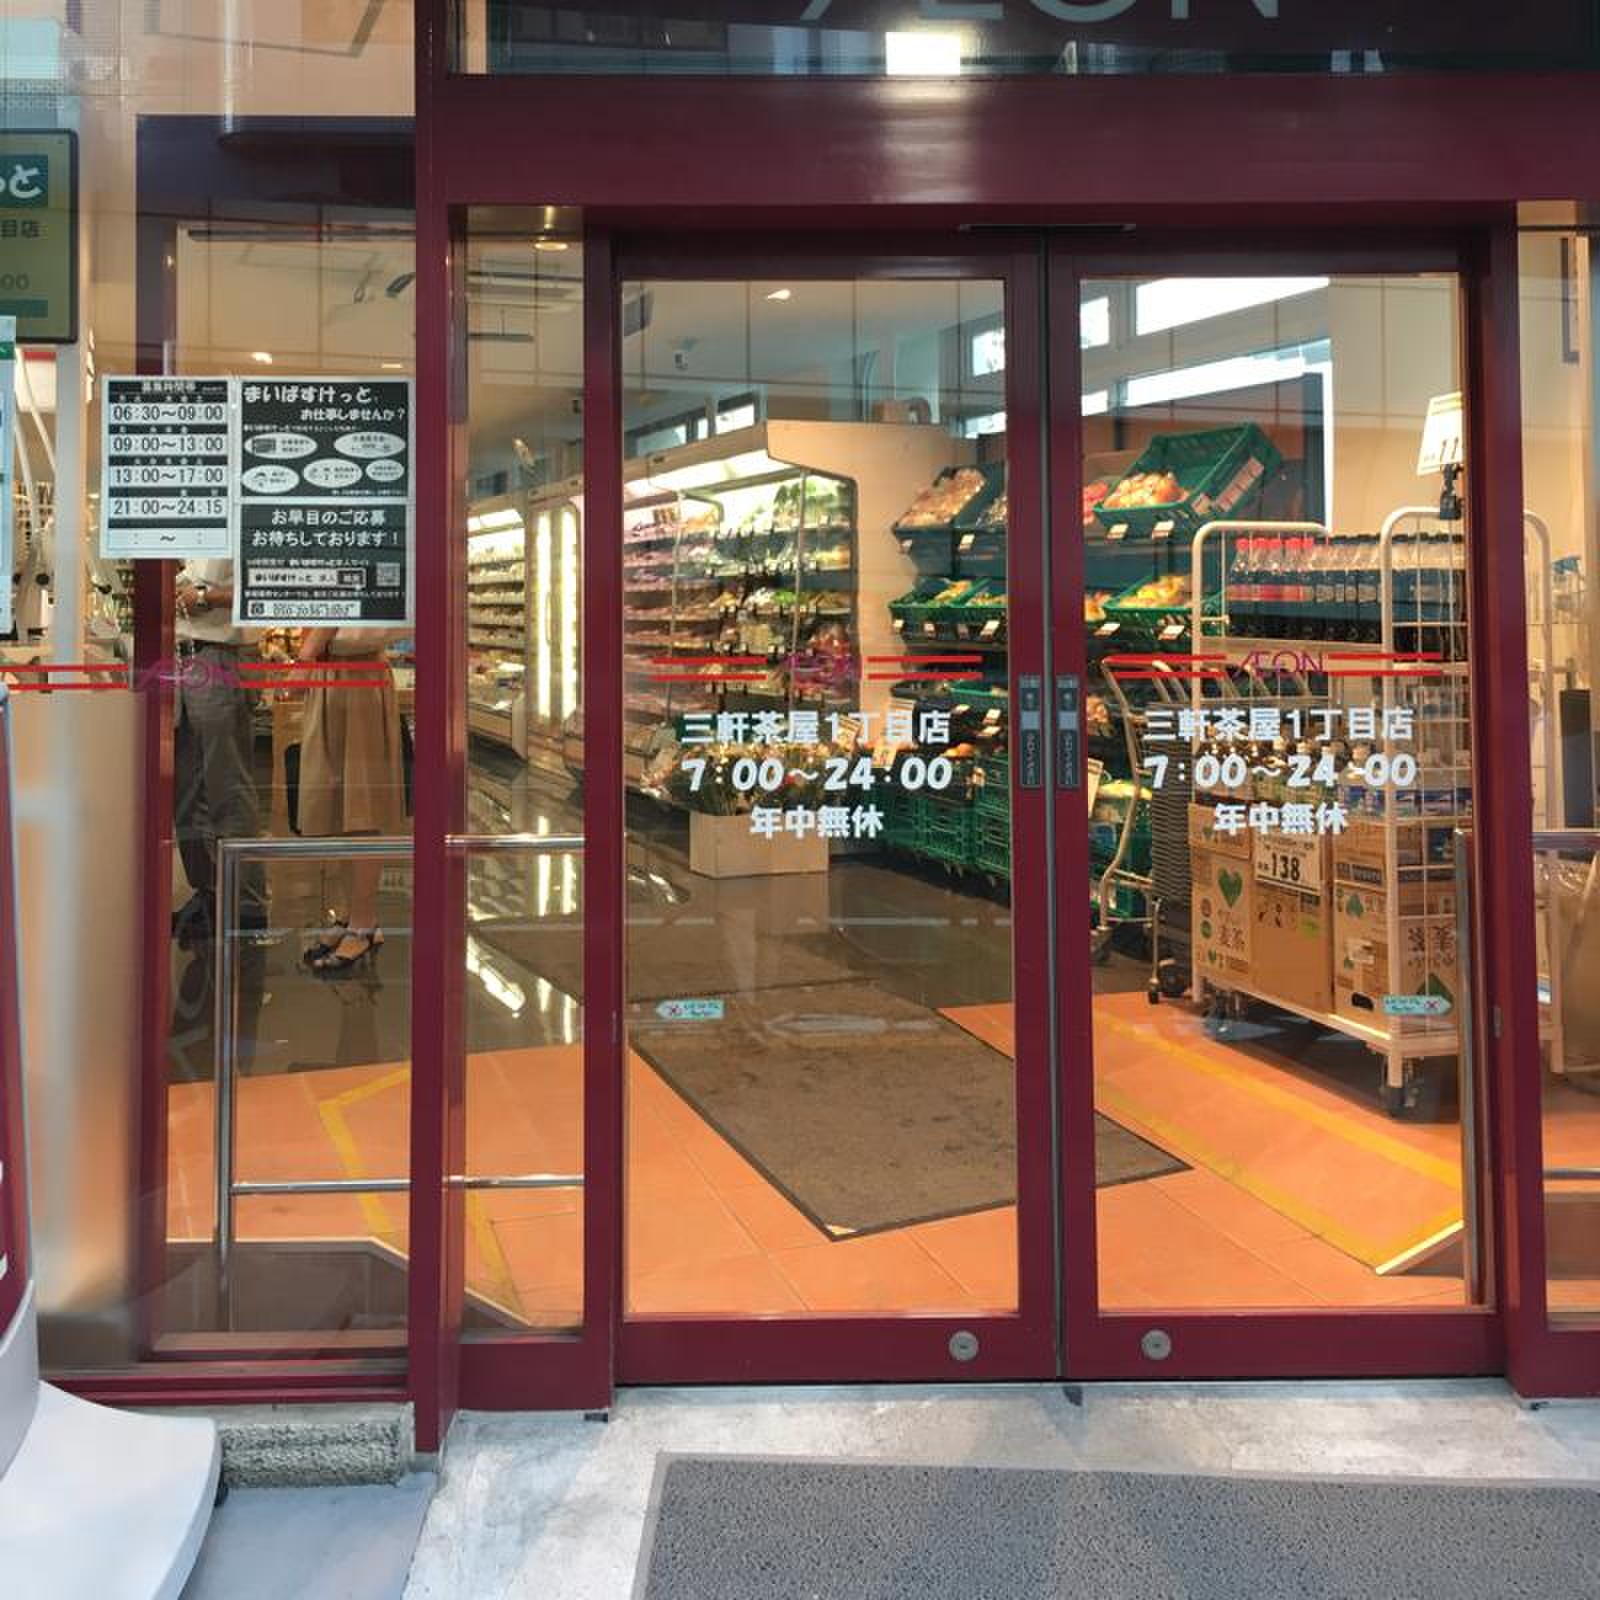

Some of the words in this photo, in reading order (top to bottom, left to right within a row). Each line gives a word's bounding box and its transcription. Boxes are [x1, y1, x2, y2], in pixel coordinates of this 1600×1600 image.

[681, 709, 952, 745] 三軒茶屋1丁目店
[1142, 707, 1415, 742] 三軒茶屋1丁目店
[749, 804, 885, 839] 年中無休
[1213, 803, 1348, 837] 年中無休
[1271, 852, 1301, 882] 138
